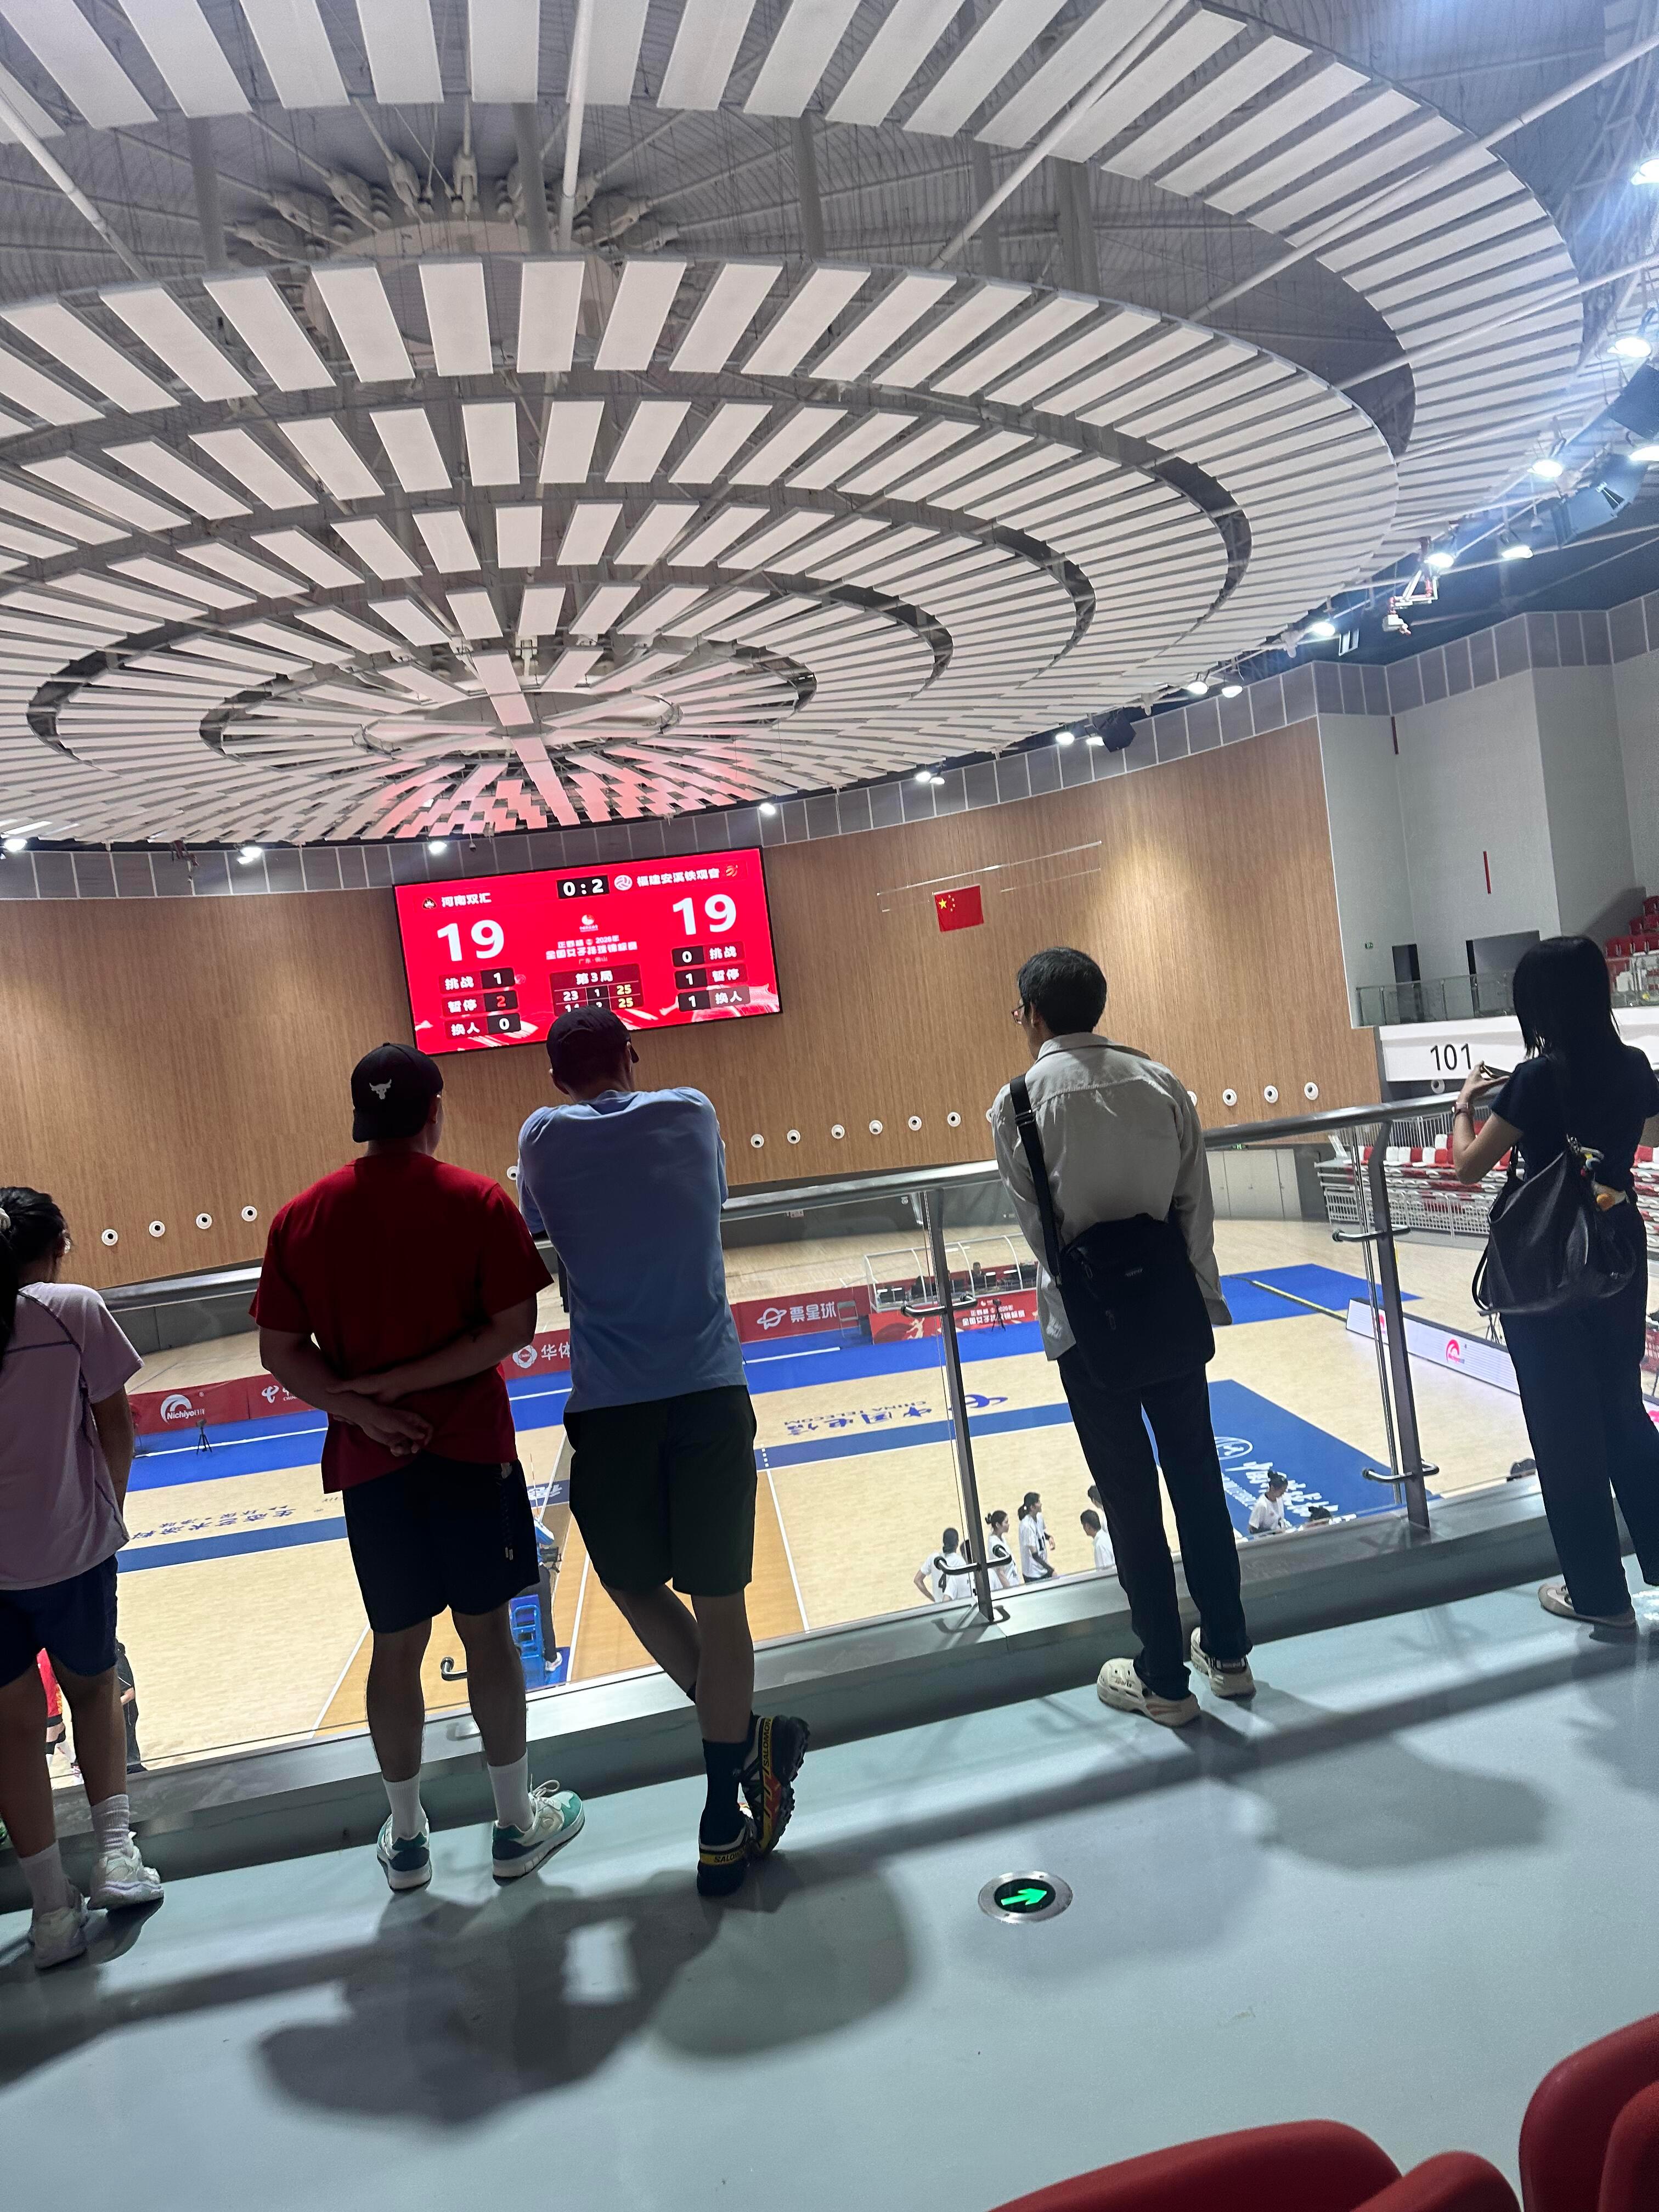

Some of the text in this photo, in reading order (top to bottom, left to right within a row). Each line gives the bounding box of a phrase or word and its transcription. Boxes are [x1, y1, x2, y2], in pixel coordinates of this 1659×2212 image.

[637, 868, 720, 887] 福建安溪铁观音
[441, 893, 492, 908] 河南双汇
[673, 894, 737, 935] 19
[437, 919, 505, 962] 19
[682, 951, 692, 963] 0
[709, 946, 737, 960] 挑战
[493, 972, 502, 985] 1
[685, 973, 693, 985] 1
[712, 968, 740, 983] 暂停
[444, 976, 475, 991] 挑战
[616, 984, 632, 995] 25
[563, 990, 579, 1002] 23
[594, 989, 600, 997] 1
[715, 991, 743, 1005] 换人
[448, 999, 477, 1013] 暂停
[496, 995, 506, 1007] 2
[618, 997, 634, 1008] 25
[688, 995, 697, 1008] 1
[451, 1022, 481, 1036] 换人
[499, 1018, 510, 1030] 0
[1430, 1043, 1471, 1071] 101
[789, 1301, 837, 1323] 票星球
